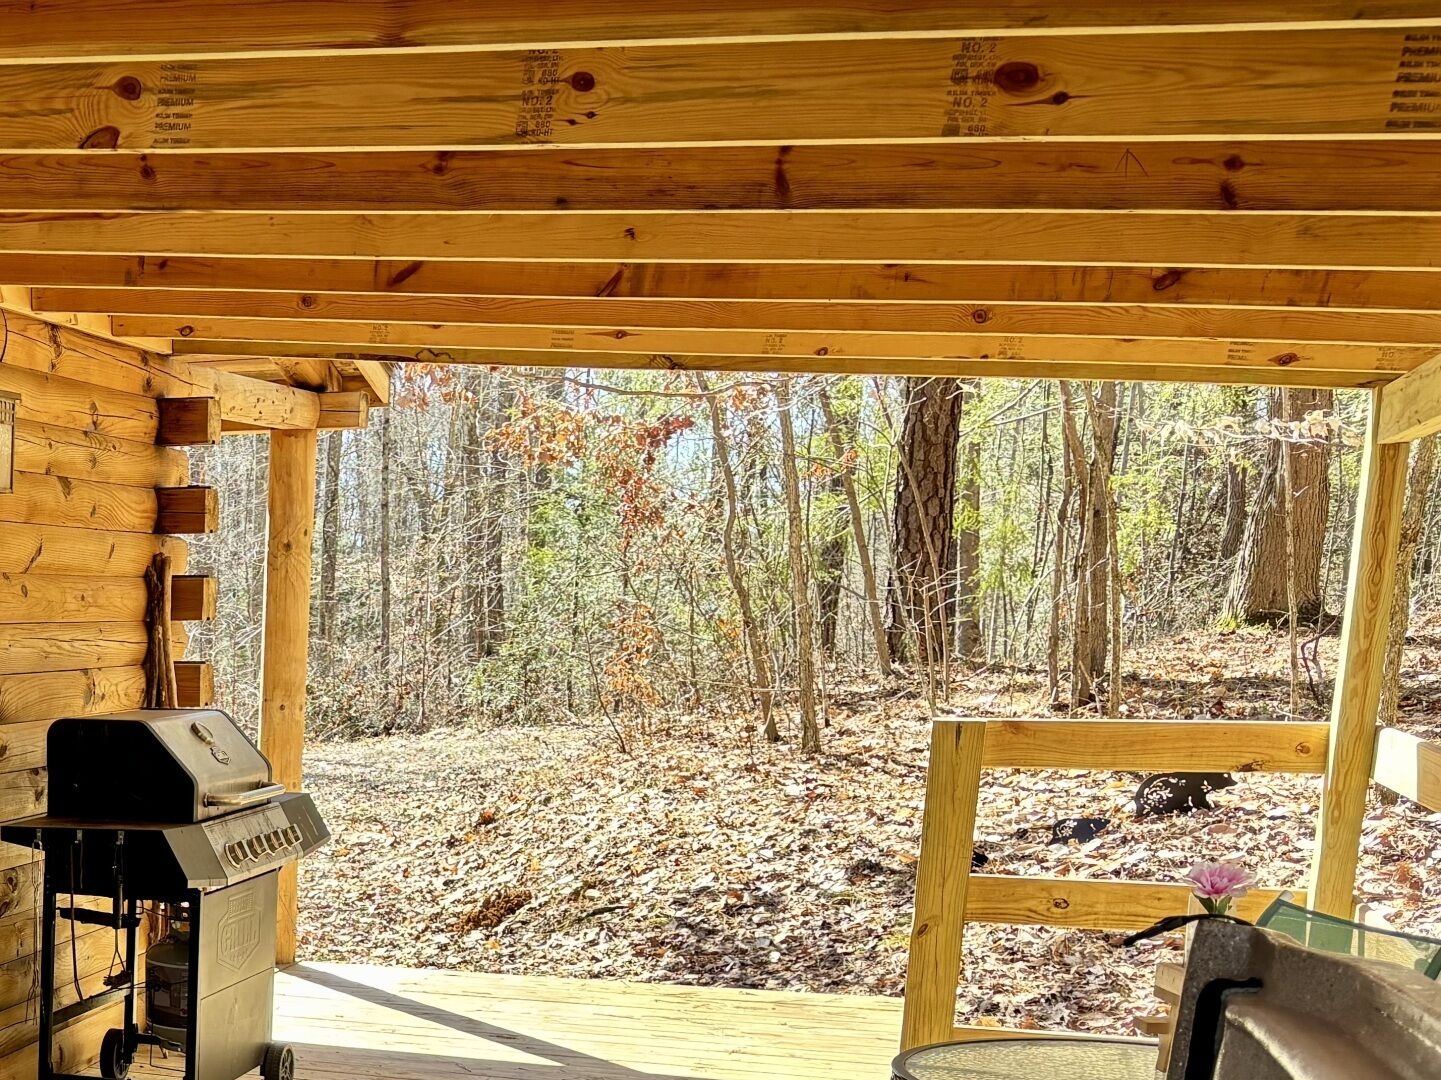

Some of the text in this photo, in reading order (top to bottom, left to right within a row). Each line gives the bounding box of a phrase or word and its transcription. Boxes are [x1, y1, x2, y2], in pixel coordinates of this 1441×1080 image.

[961, 42, 997, 53] NO. 2
[522, 95, 553, 106] NO. 2
[952, 97, 988, 108] NO. 2
